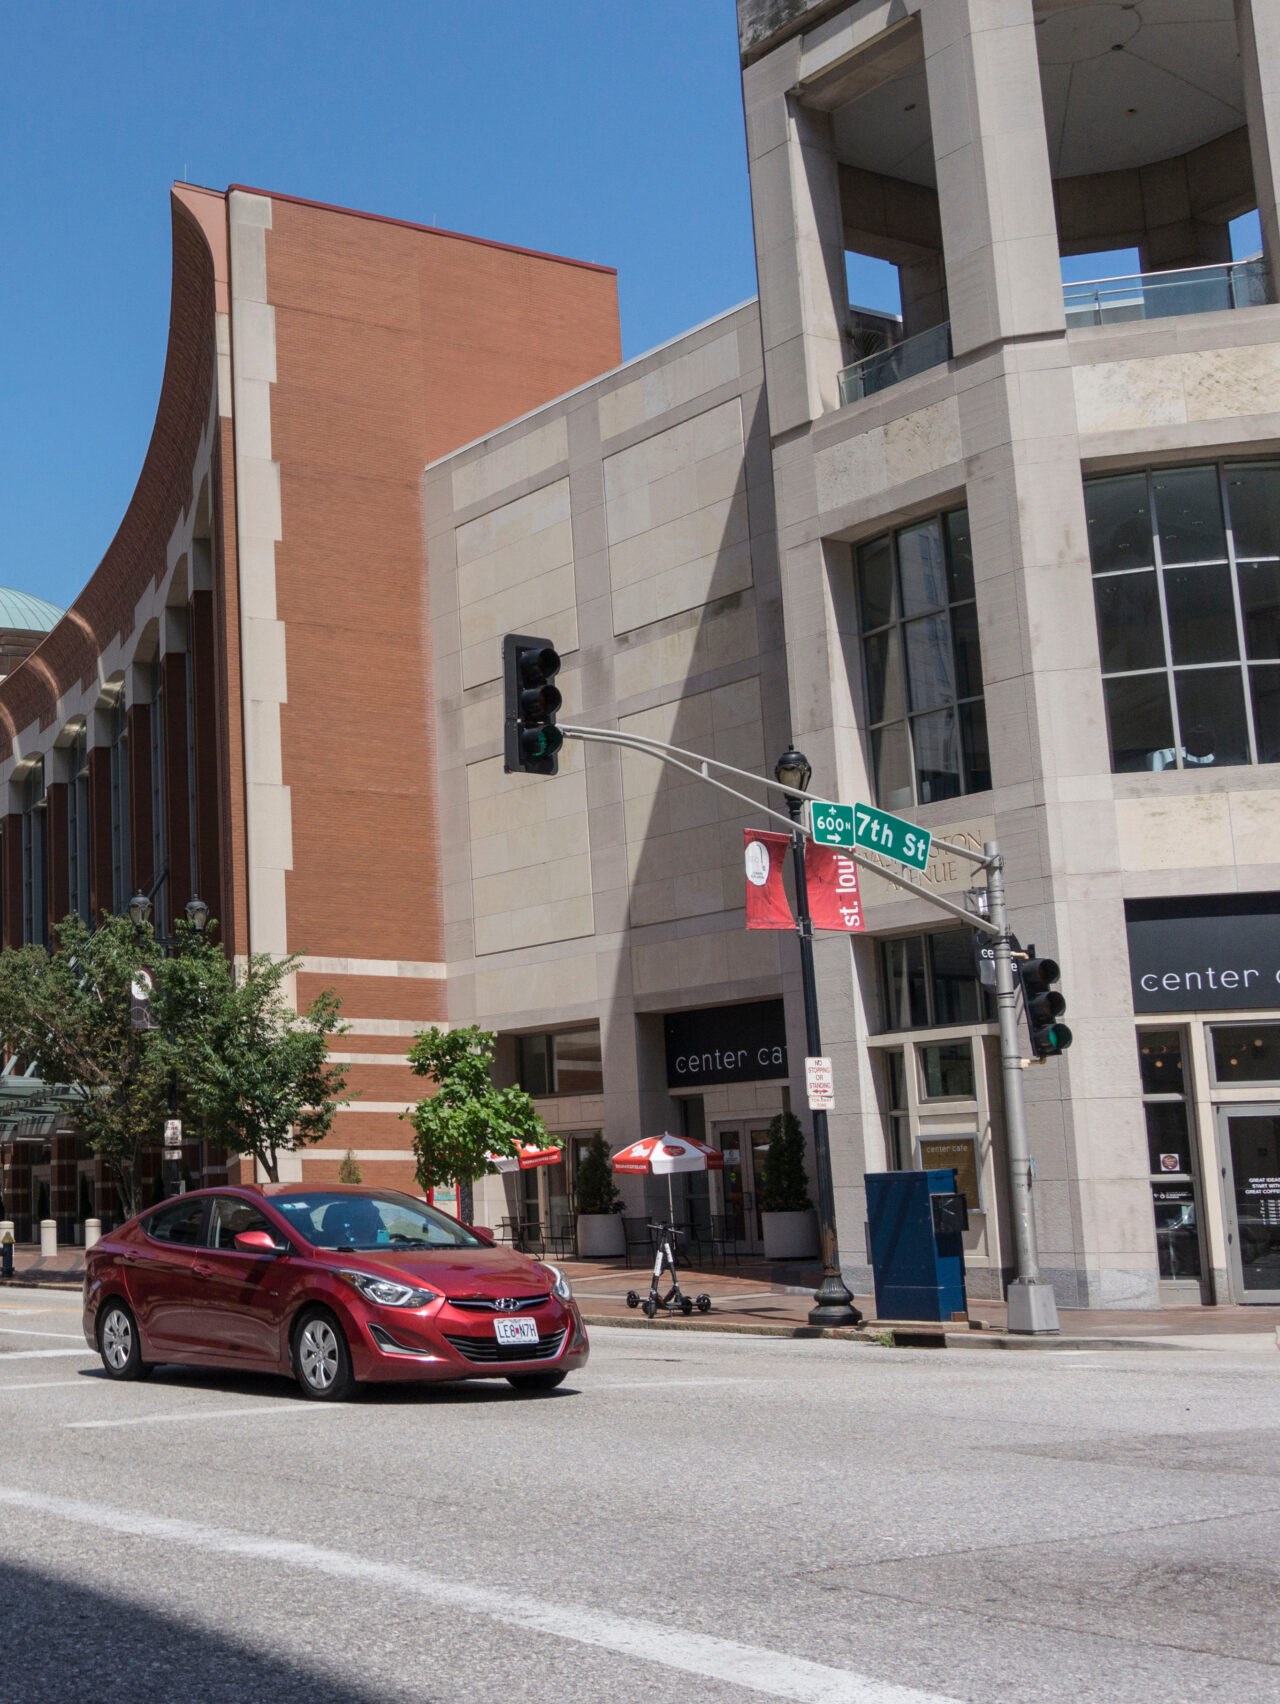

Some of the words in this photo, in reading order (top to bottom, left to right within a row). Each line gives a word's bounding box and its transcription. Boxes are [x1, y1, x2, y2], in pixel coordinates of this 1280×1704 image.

[856, 811, 895, 848] 7th
[903, 833, 926, 861] St
[833, 852, 857, 893] loui
[839, 900, 860, 926] st.
[1140, 967, 1259, 992] center
[675, 1048, 748, 1074] center
[757, 1046, 784, 1067] ca
[926, 1145, 950, 1153] center
[952, 1144, 968, 1152] cafe
